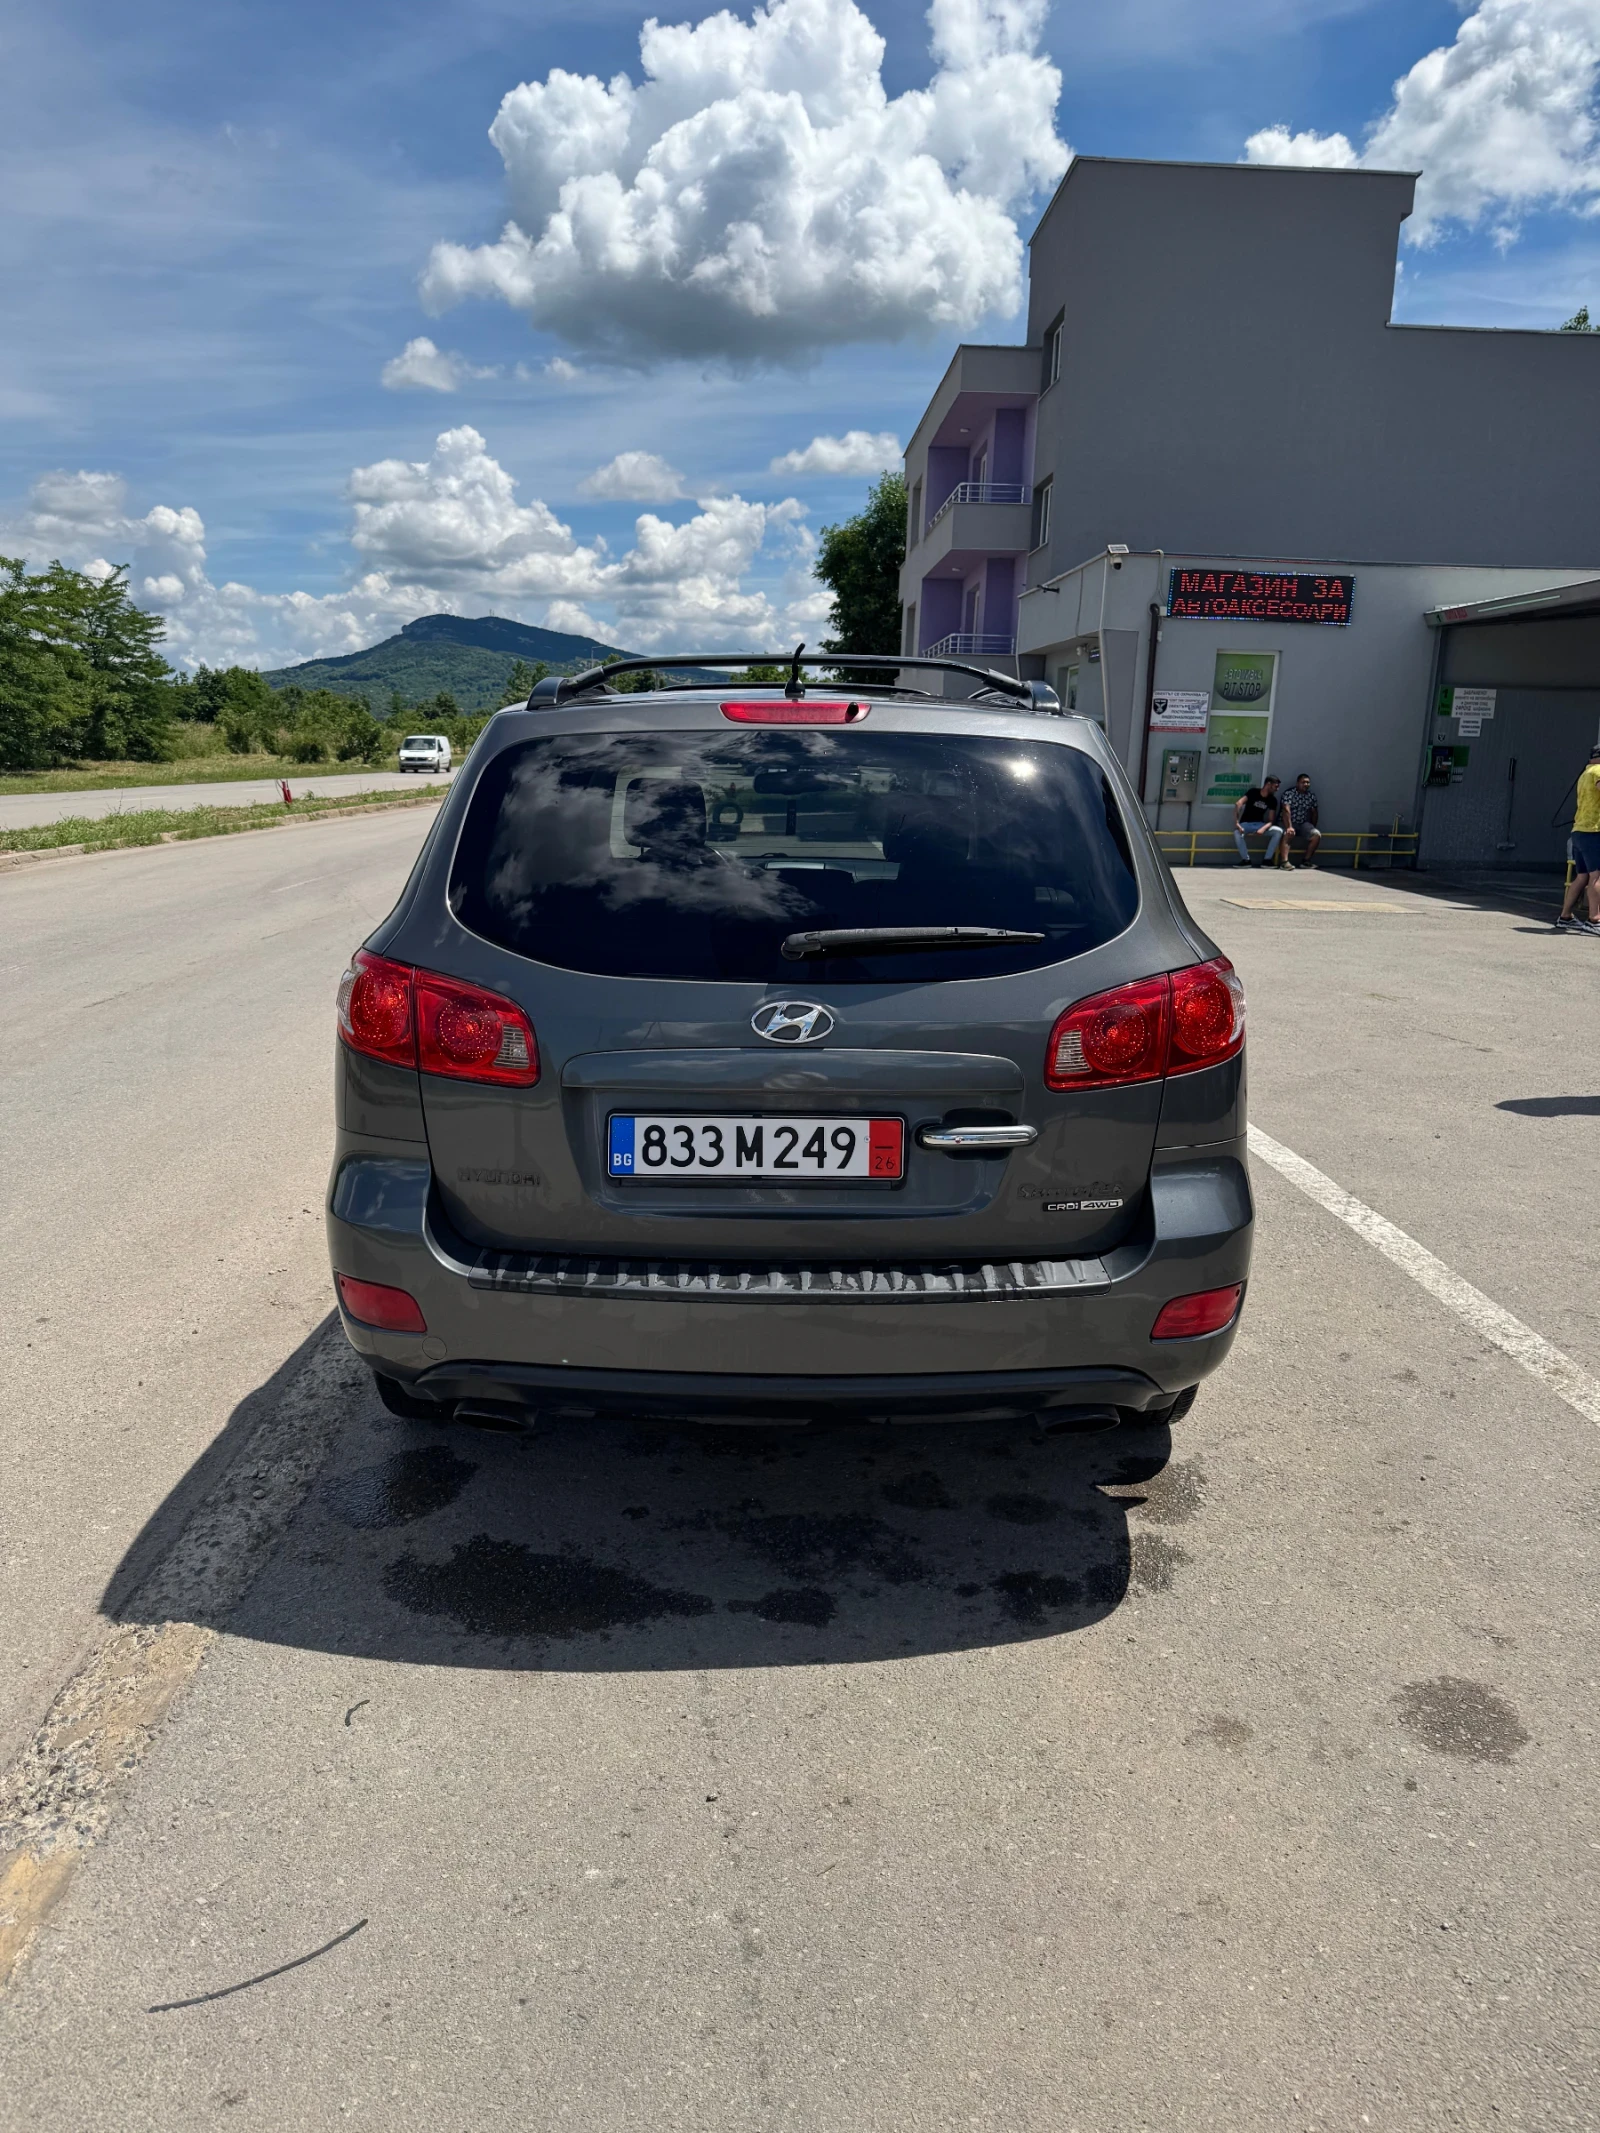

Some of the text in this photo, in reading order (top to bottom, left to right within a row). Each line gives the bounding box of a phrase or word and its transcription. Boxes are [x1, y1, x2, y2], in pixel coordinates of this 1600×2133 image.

[1180, 573, 1344, 598] МАГАЗИН ЗА
[1223, 682, 1261, 697] PIT STOP
[1208, 746, 1264, 755] CAR WASH
[642, 1124, 856, 1169] 833 M 249
[613, 1154, 632, 1166] BG
[874, 1156, 895, 1170] 26
[1047, 1200, 1119, 1211] CRDi 4WD
